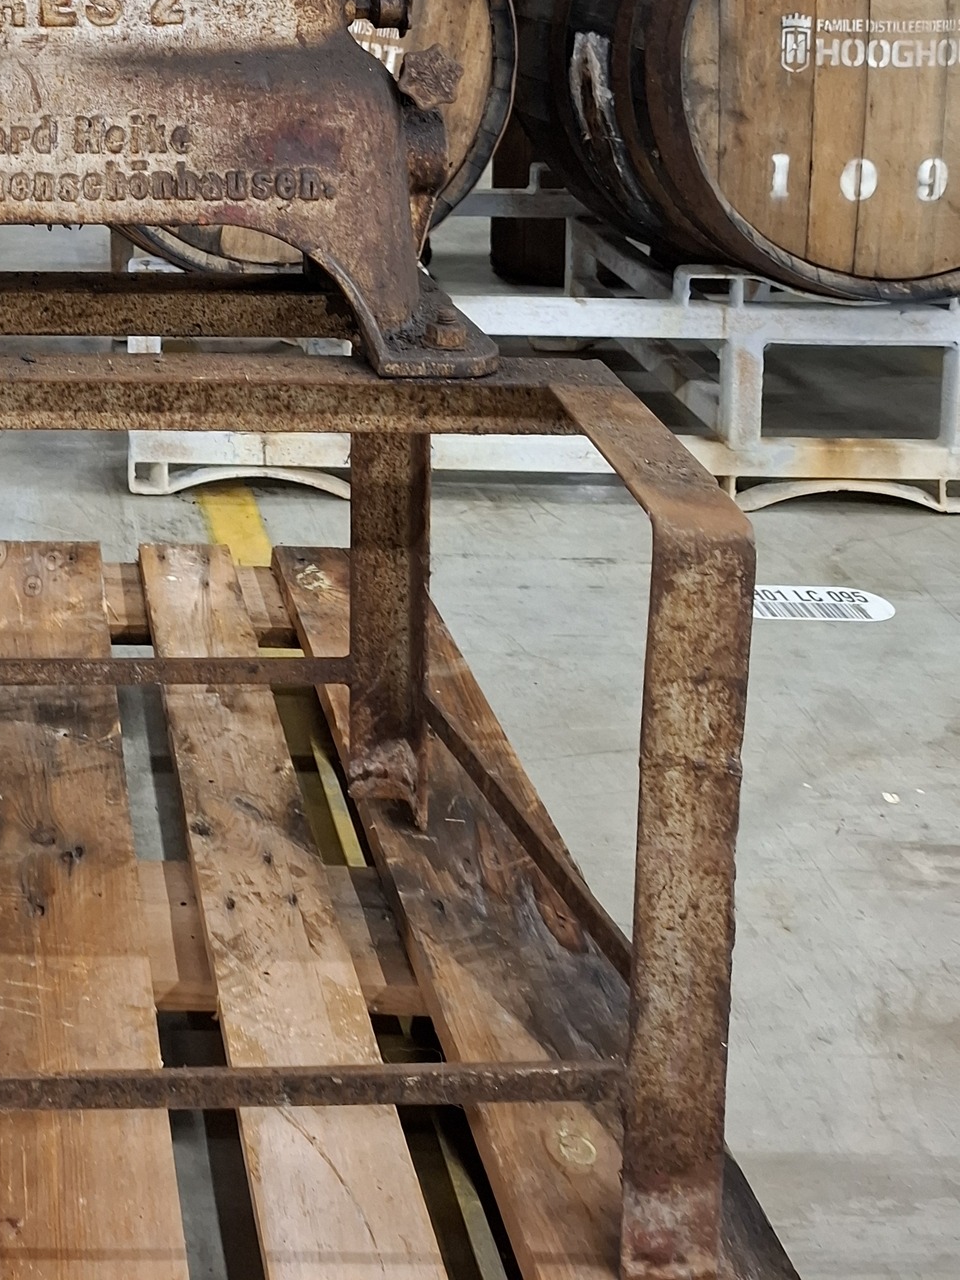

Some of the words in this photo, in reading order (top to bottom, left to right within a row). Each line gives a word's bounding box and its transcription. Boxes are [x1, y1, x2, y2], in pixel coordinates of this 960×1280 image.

[816, 18, 863, 32] FAMILIE
[816, 38, 960, 68] HOOGHO
[73, 113, 192, 155] Heike
[792, 589, 823, 602] LC
[826, 590, 869, 602] 095
